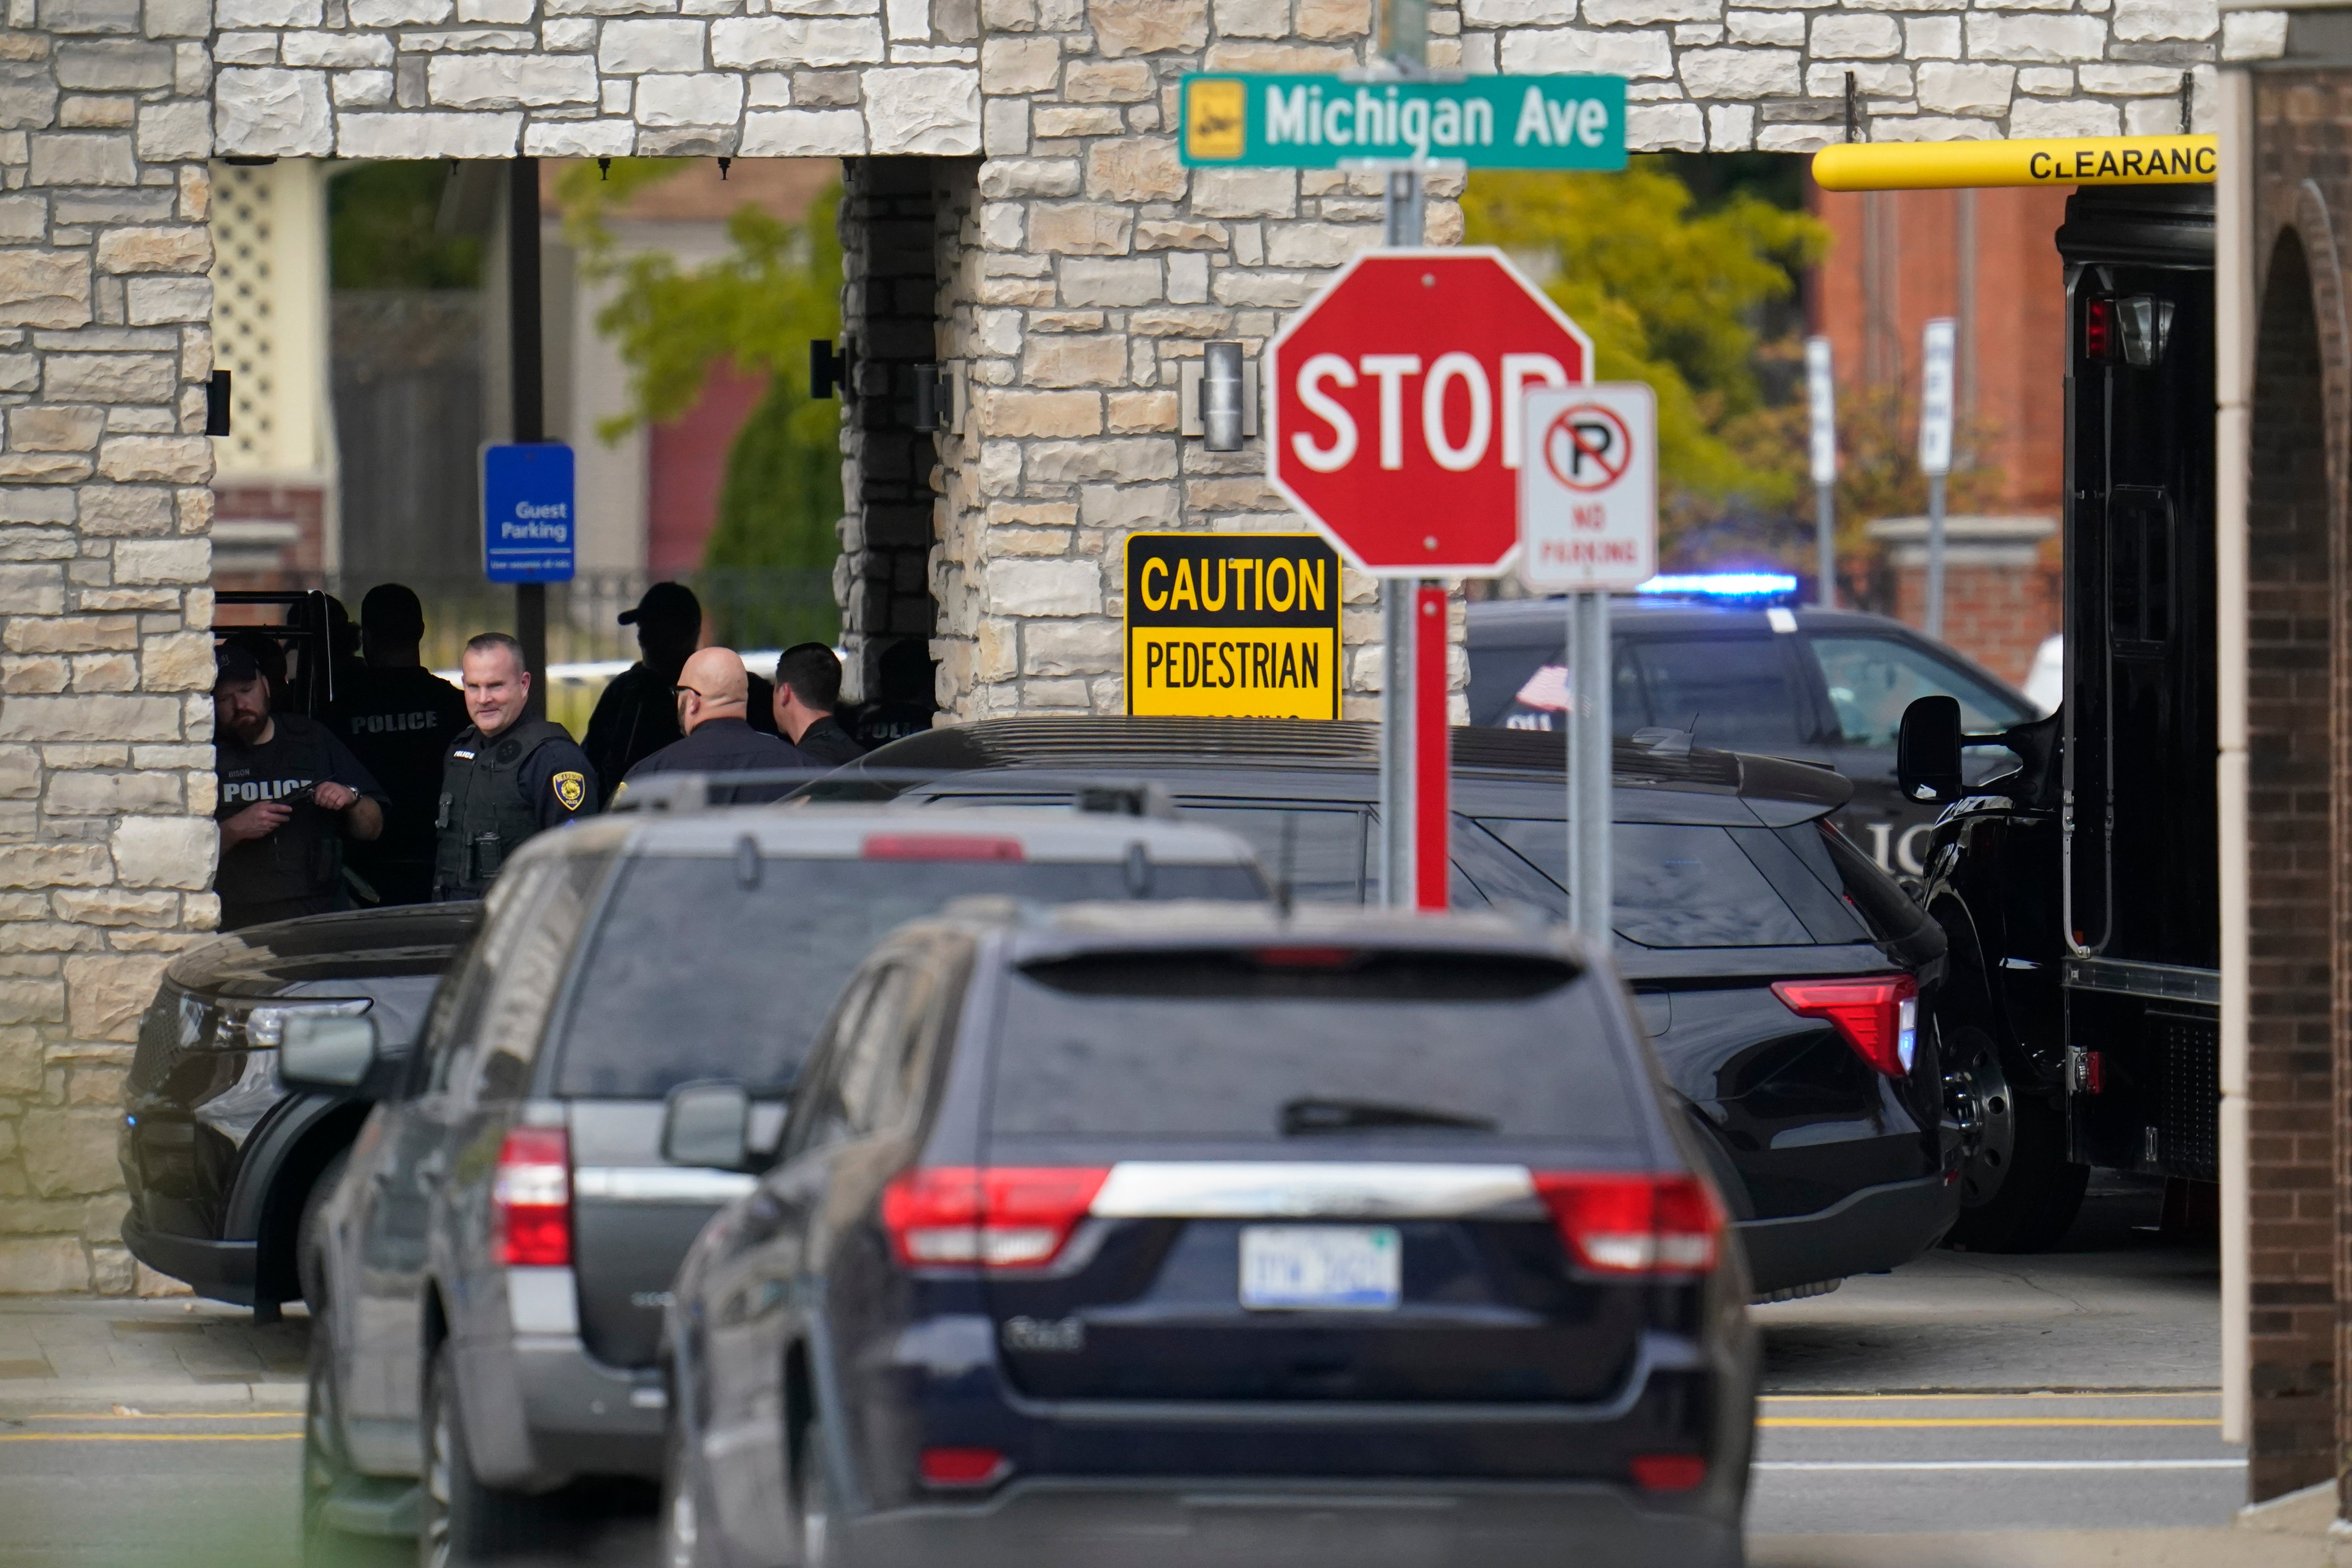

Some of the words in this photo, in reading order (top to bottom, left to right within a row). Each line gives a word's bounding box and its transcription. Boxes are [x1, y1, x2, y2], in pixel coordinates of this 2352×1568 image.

[1266, 84, 1494, 159] Michigan
[1515, 85, 1608, 146] Ave
[1292, 352, 1569, 471] STOP
[516, 501, 567, 518] Guest
[1572, 505, 1605, 529] NO
[502, 521, 567, 542] Parking
[1540, 540, 1638, 563] PARKING
[1141, 557, 1325, 612] CAUTION
[1147, 641, 1319, 688] PEDESTRIAN
[351, 710, 438, 734] POLICE
[856, 721, 920, 740] POLI
[223, 779, 312, 802] POLIC
